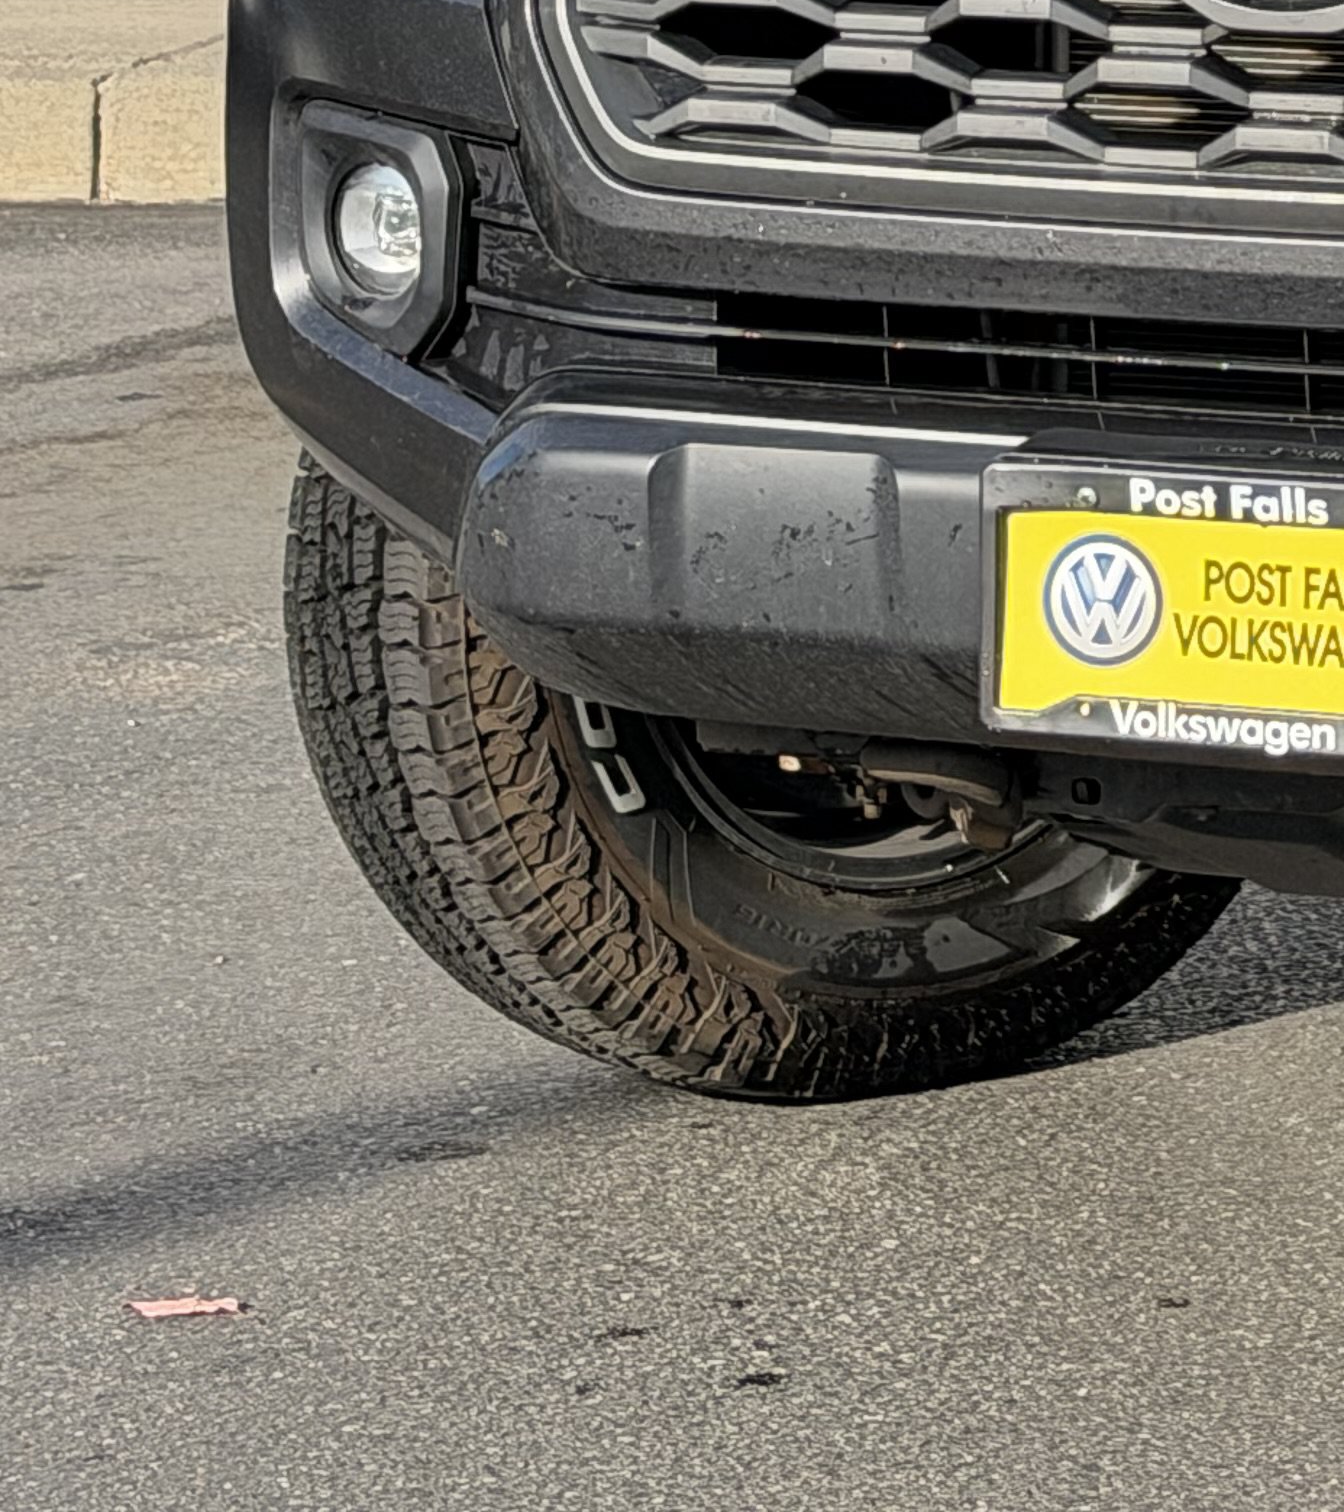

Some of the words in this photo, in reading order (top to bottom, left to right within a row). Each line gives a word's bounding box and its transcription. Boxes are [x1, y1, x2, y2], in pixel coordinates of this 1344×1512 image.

[1129, 478, 1217, 520] Post
[1229, 485, 1329, 527] Falls
[1204, 558, 1292, 607] POST
[1110, 699, 1337, 756] Volkswagen
